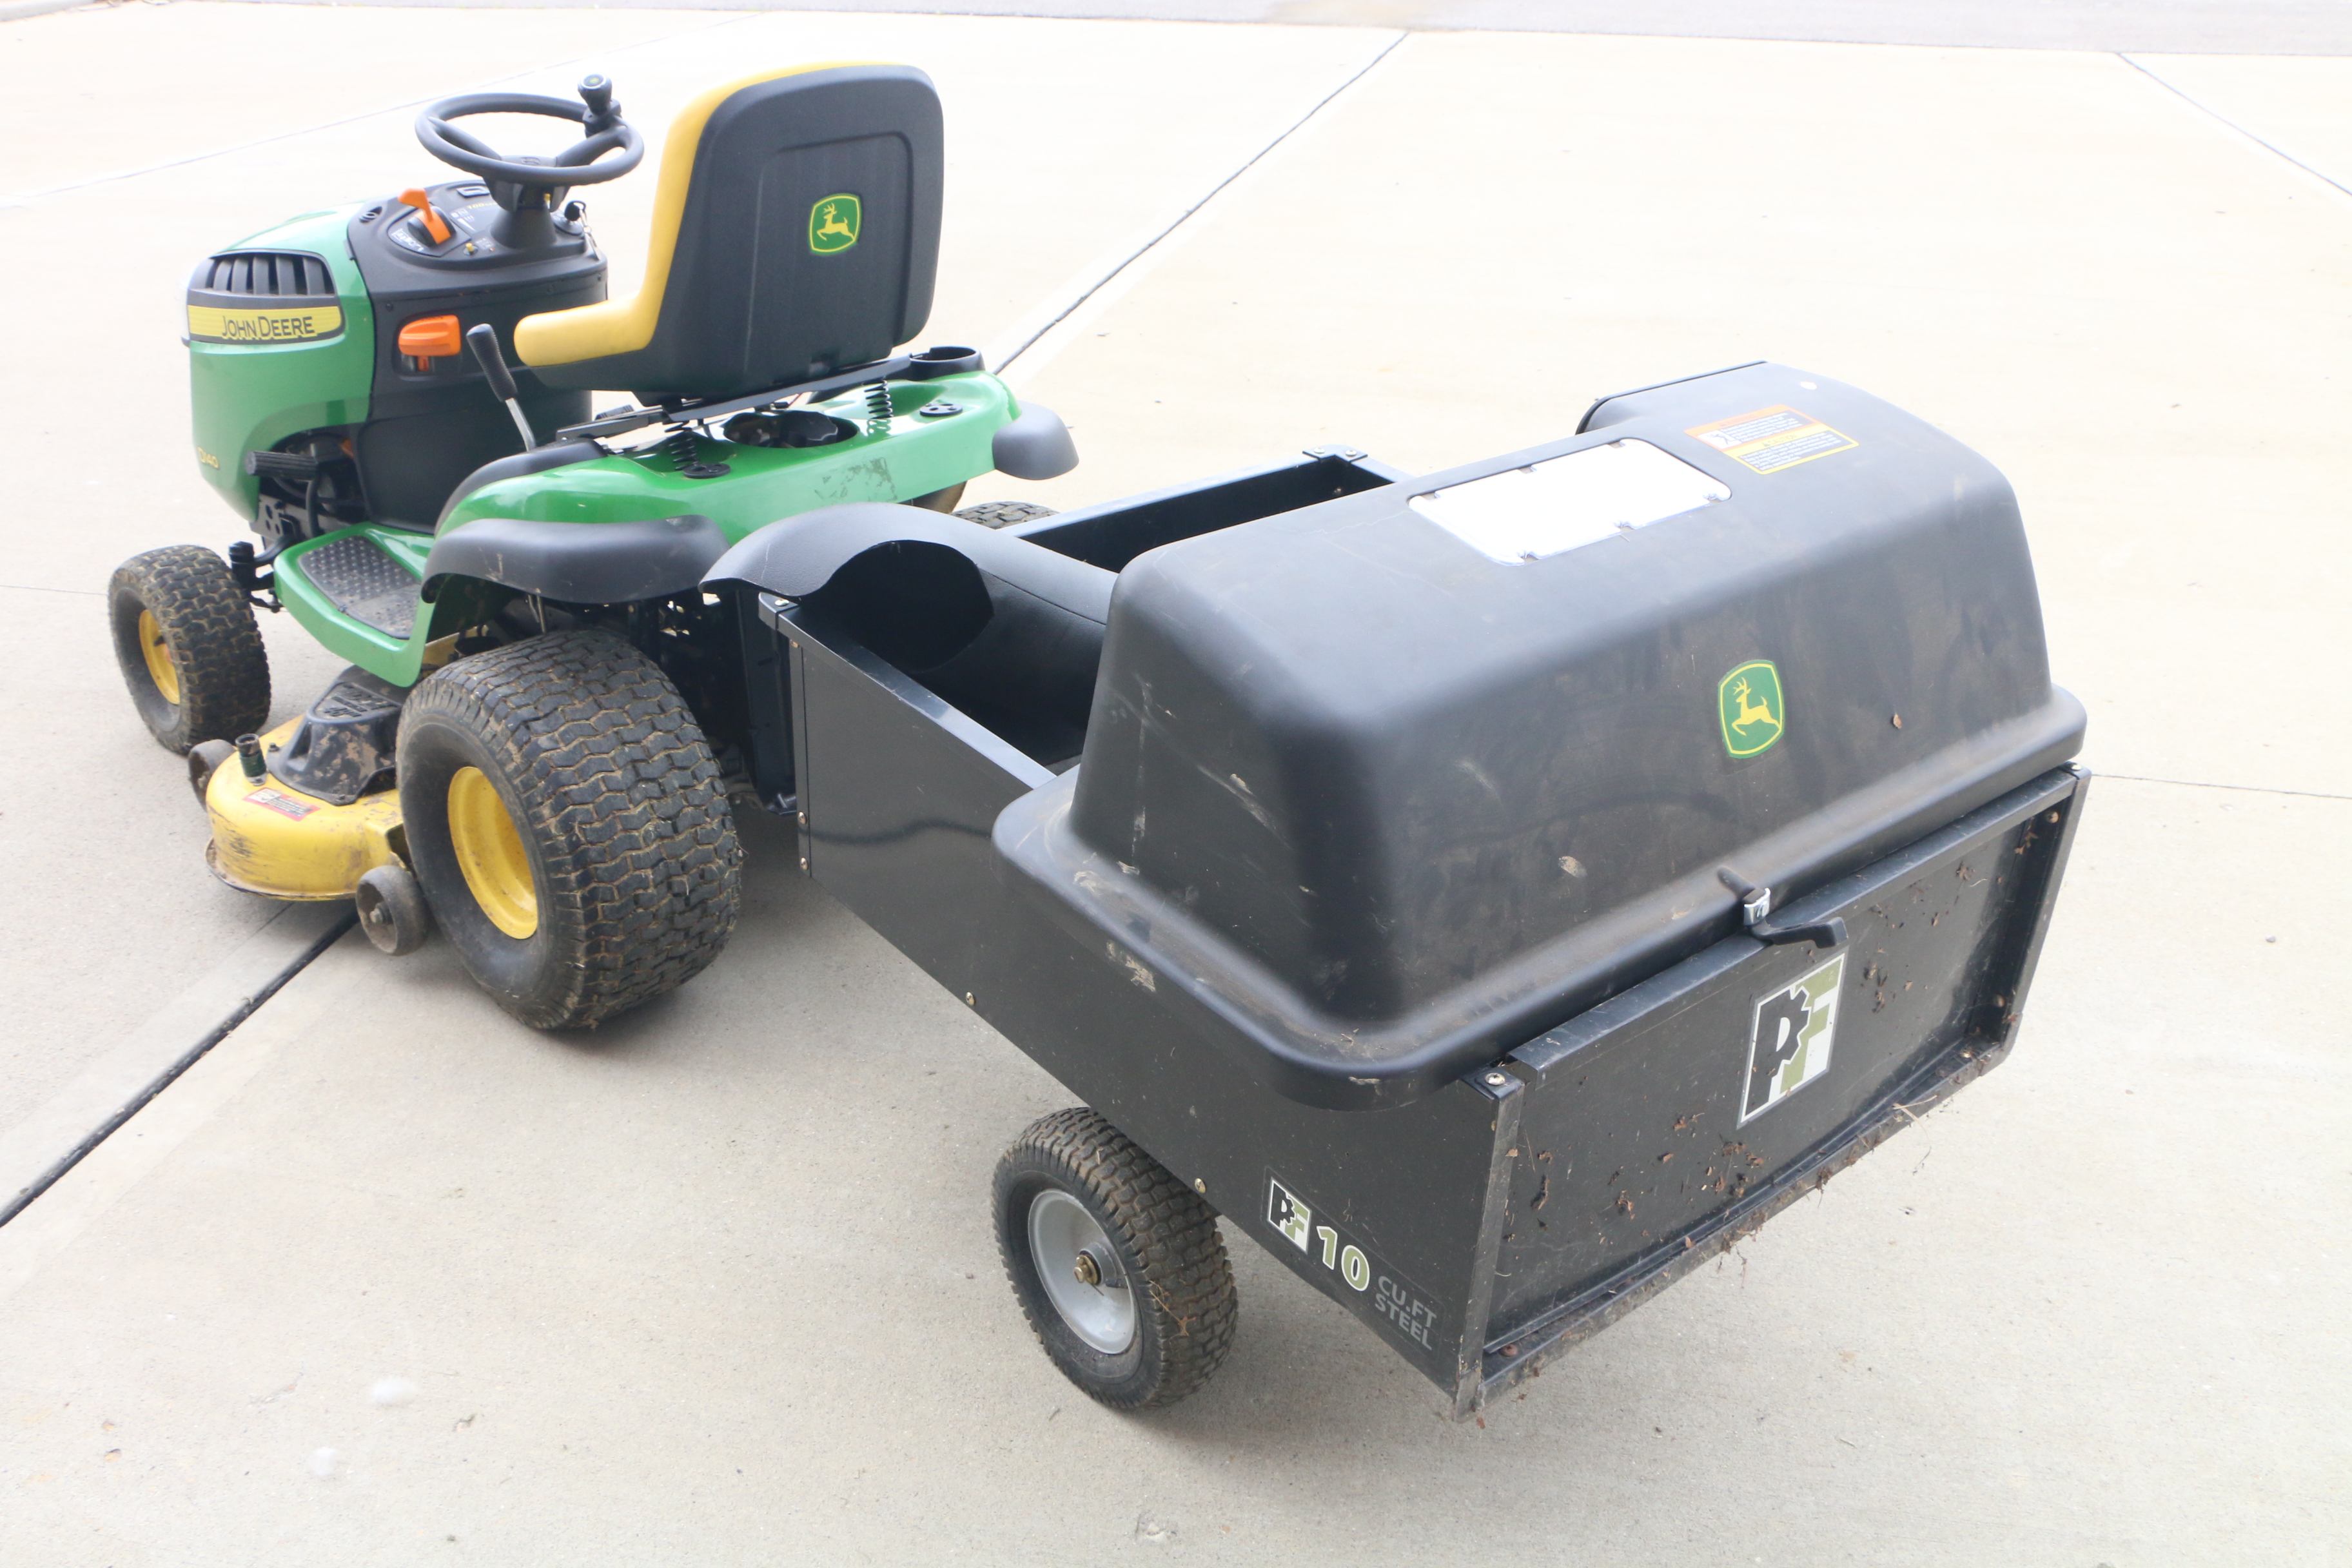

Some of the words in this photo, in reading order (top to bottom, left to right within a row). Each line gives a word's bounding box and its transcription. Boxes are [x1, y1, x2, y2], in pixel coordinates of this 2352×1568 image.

[222, 315, 257, 337] JOHN
[258, 316, 315, 337] DEERE
[1316, 1225, 1371, 1292] 10
[1375, 1294, 1433, 1351] STEEL
